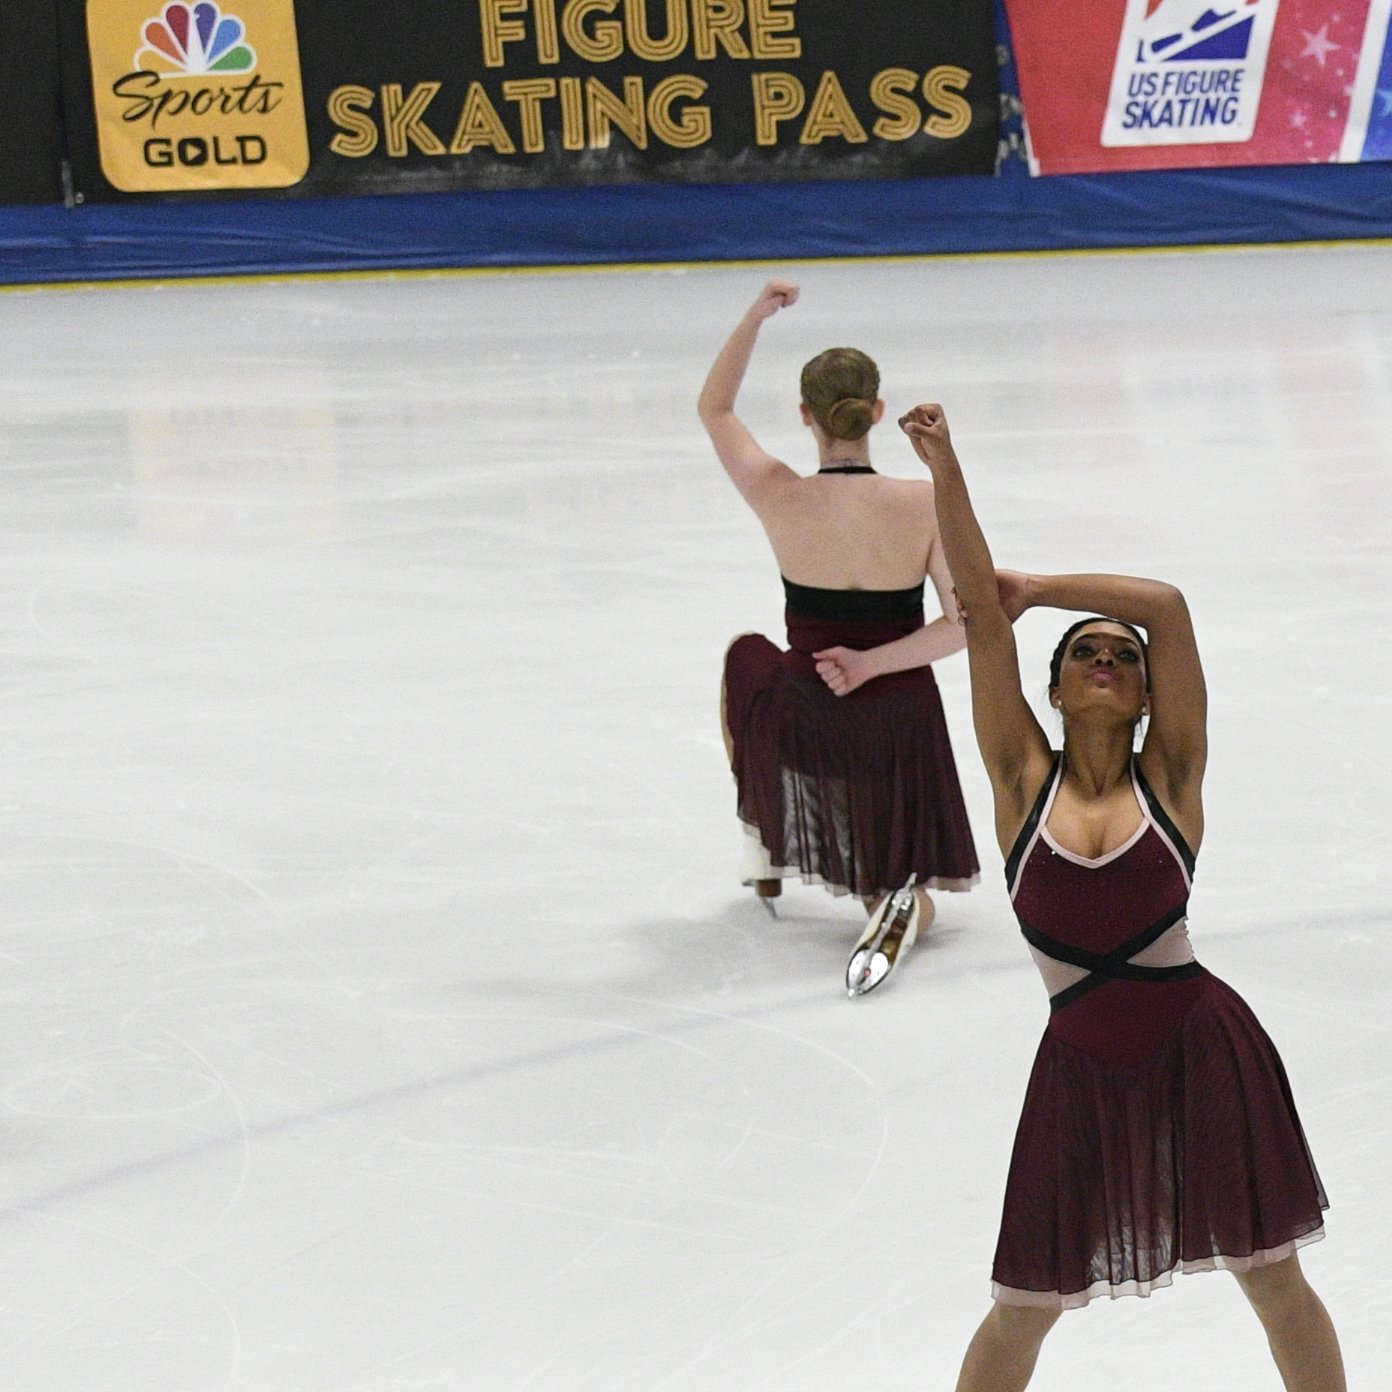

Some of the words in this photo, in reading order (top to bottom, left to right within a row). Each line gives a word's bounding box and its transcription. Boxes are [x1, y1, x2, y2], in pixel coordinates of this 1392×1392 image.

[480, 0, 801, 67] FIGURE
[112, 70, 284, 130] Sports
[1128, 71, 1158, 95] US
[1161, 68, 1244, 94] FIGURE
[328, 74, 712, 157] SKATING
[752, 65, 972, 146] PASS
[1122, 96, 1240, 129] SKATING
[143, 135, 267, 168] GOLD
